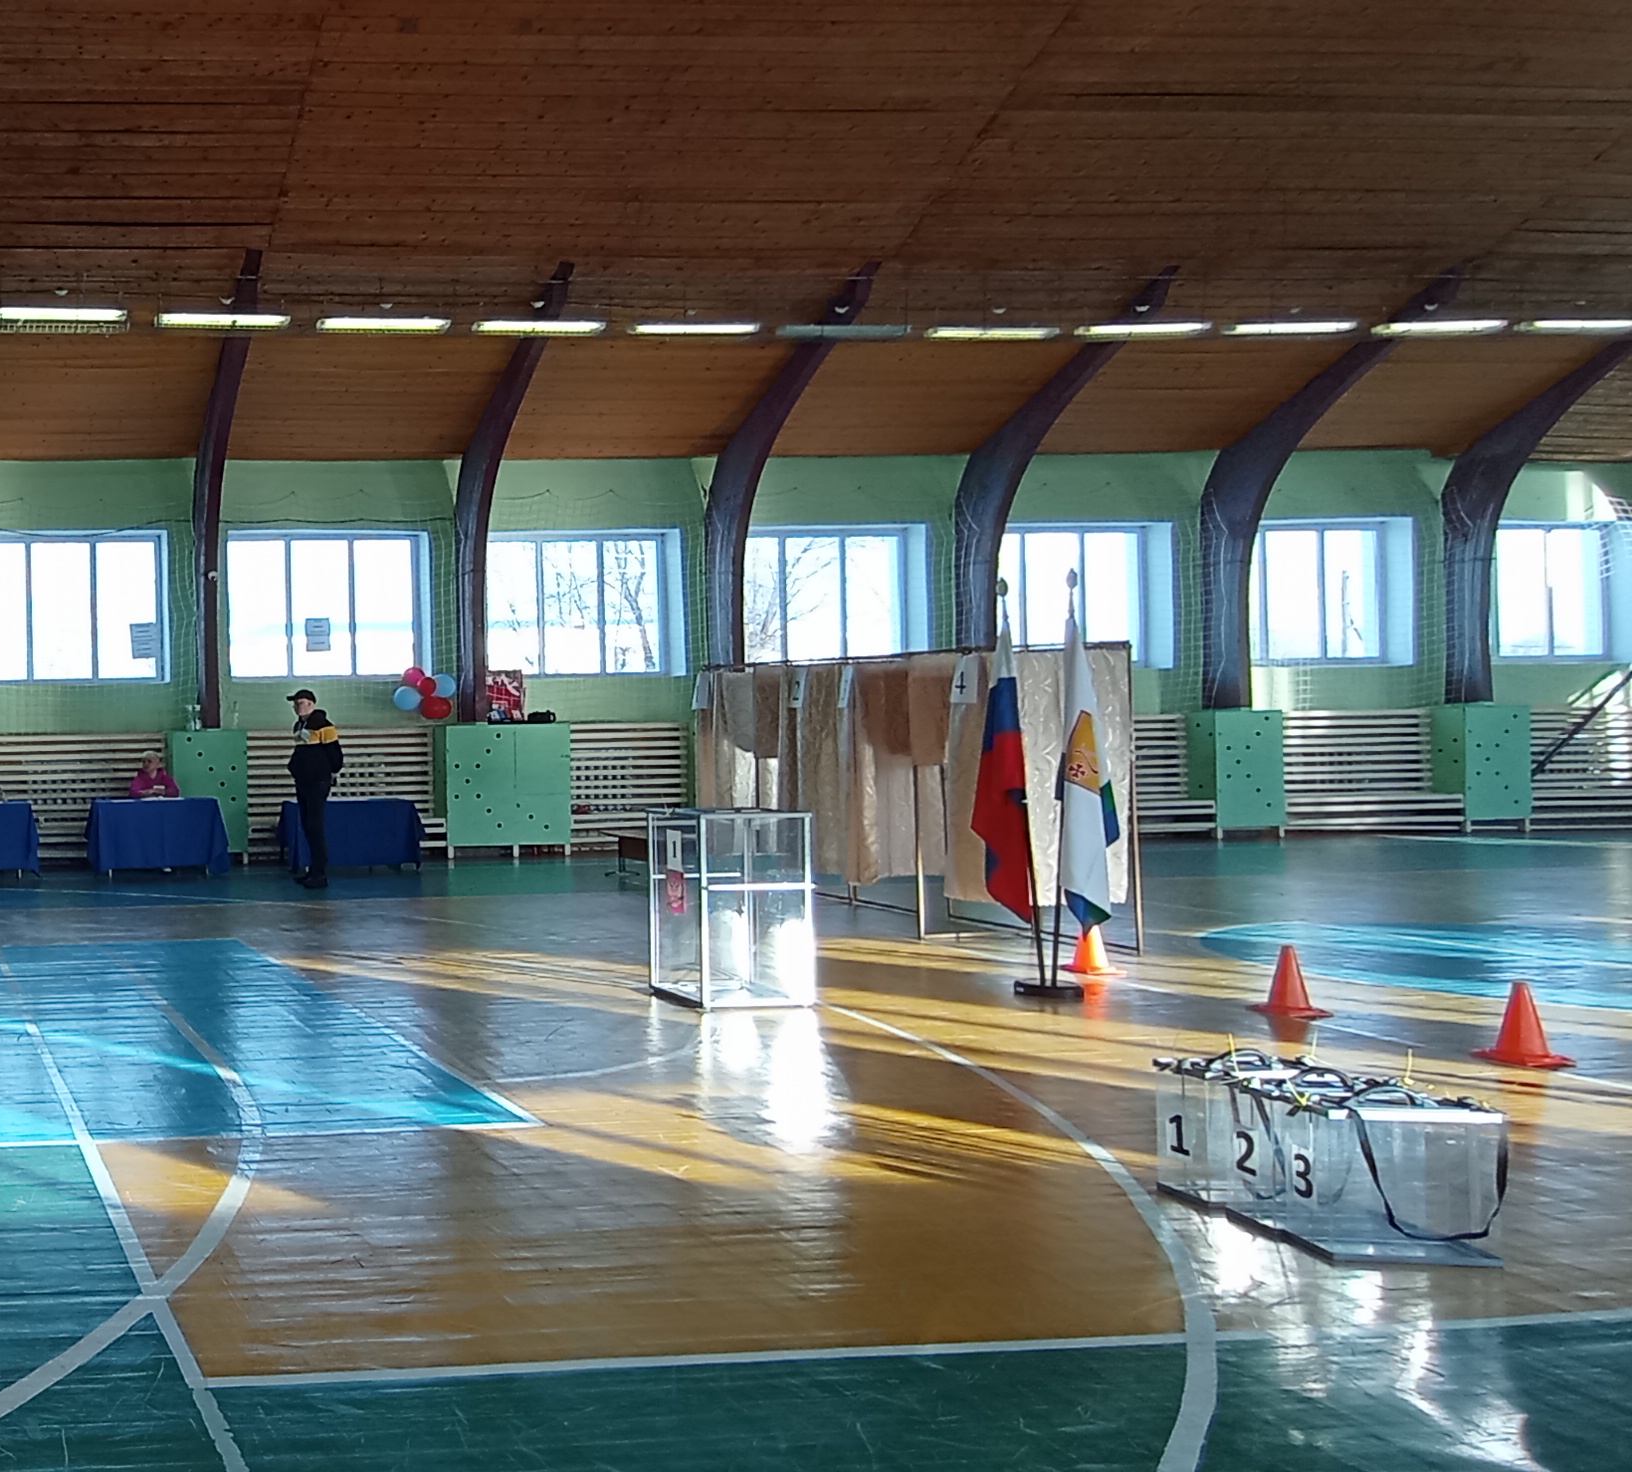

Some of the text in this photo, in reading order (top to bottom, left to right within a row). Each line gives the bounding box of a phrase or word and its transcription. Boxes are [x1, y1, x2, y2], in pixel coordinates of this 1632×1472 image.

[955, 671, 966, 695] 4
[672, 840, 678, 859] 1
[1169, 1114, 1190, 1157] 1
[1235, 1131, 1257, 1177] 2
[1293, 1153, 1313, 1199] 3
